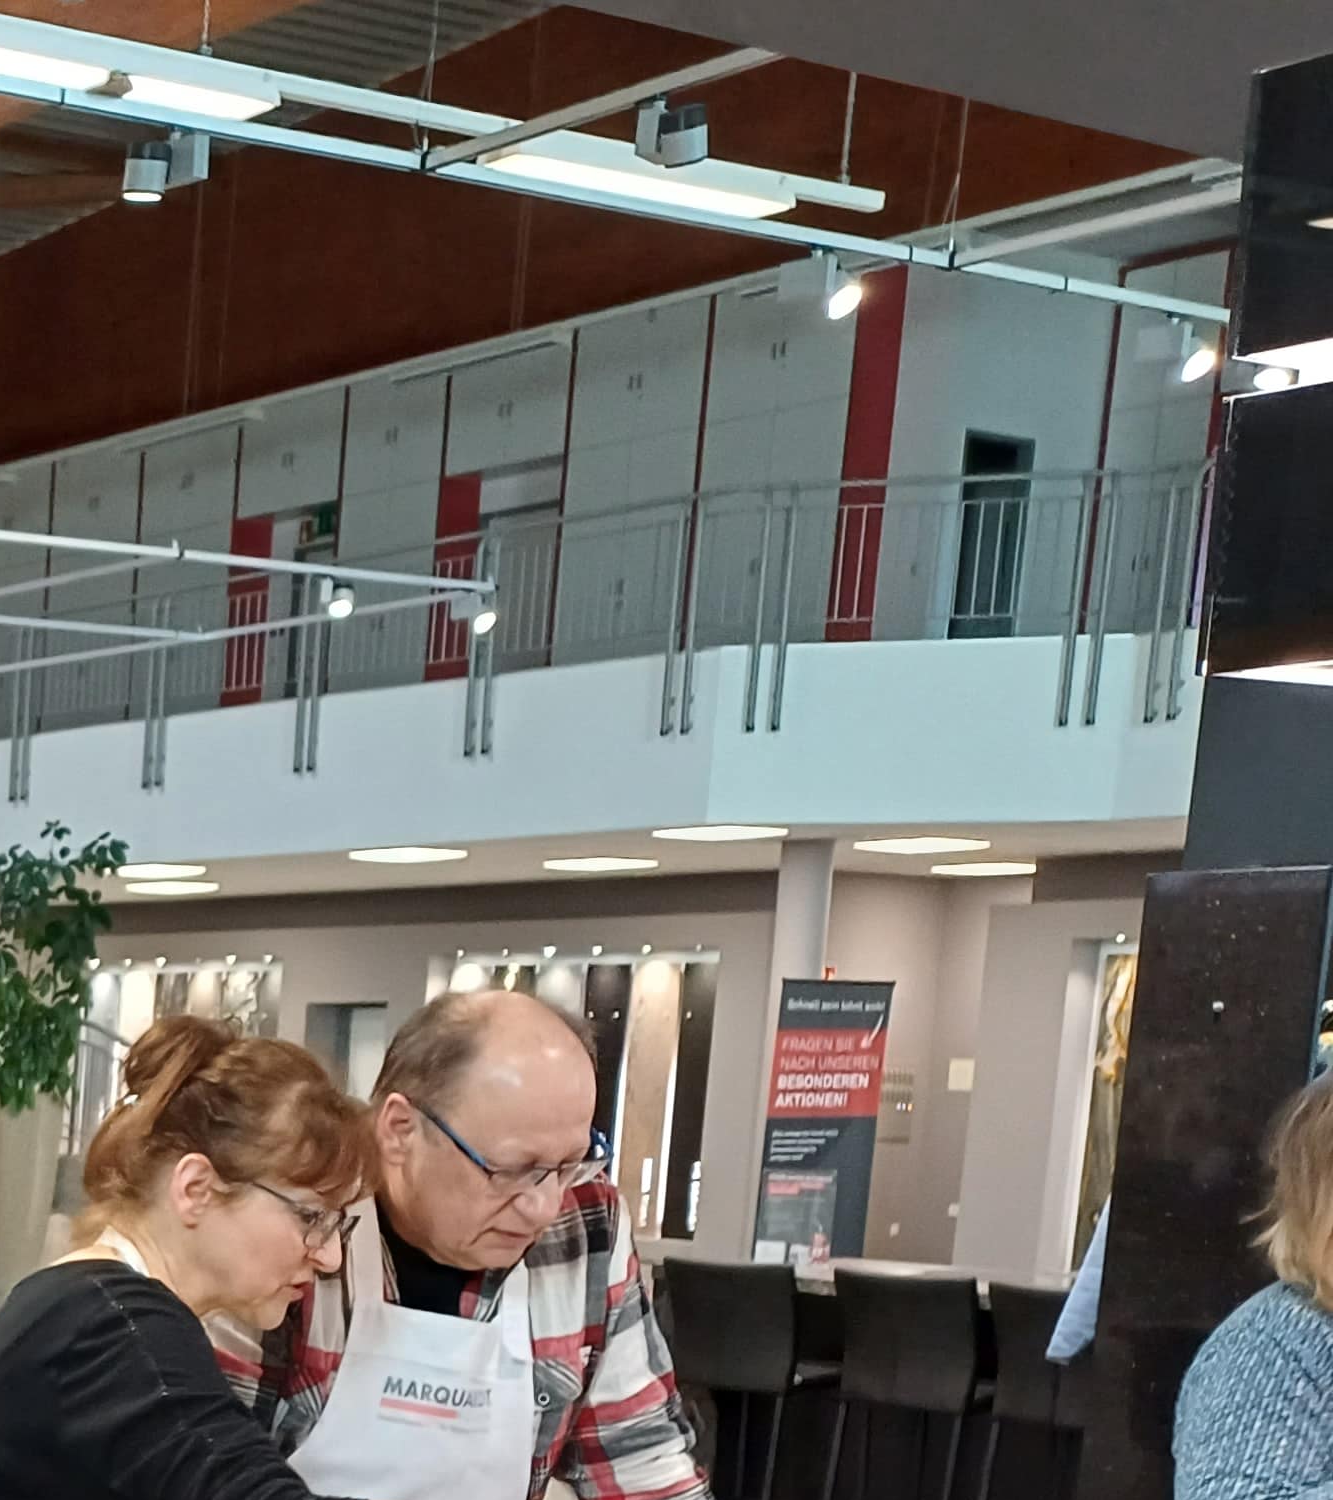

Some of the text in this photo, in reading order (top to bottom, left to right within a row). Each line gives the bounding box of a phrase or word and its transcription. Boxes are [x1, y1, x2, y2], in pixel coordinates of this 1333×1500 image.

[781, 1036, 834, 1053] FRAGEN
[779, 1055, 880, 1071] NACH UNSEREN
[777, 1073, 870, 1090] BESONDEREN
